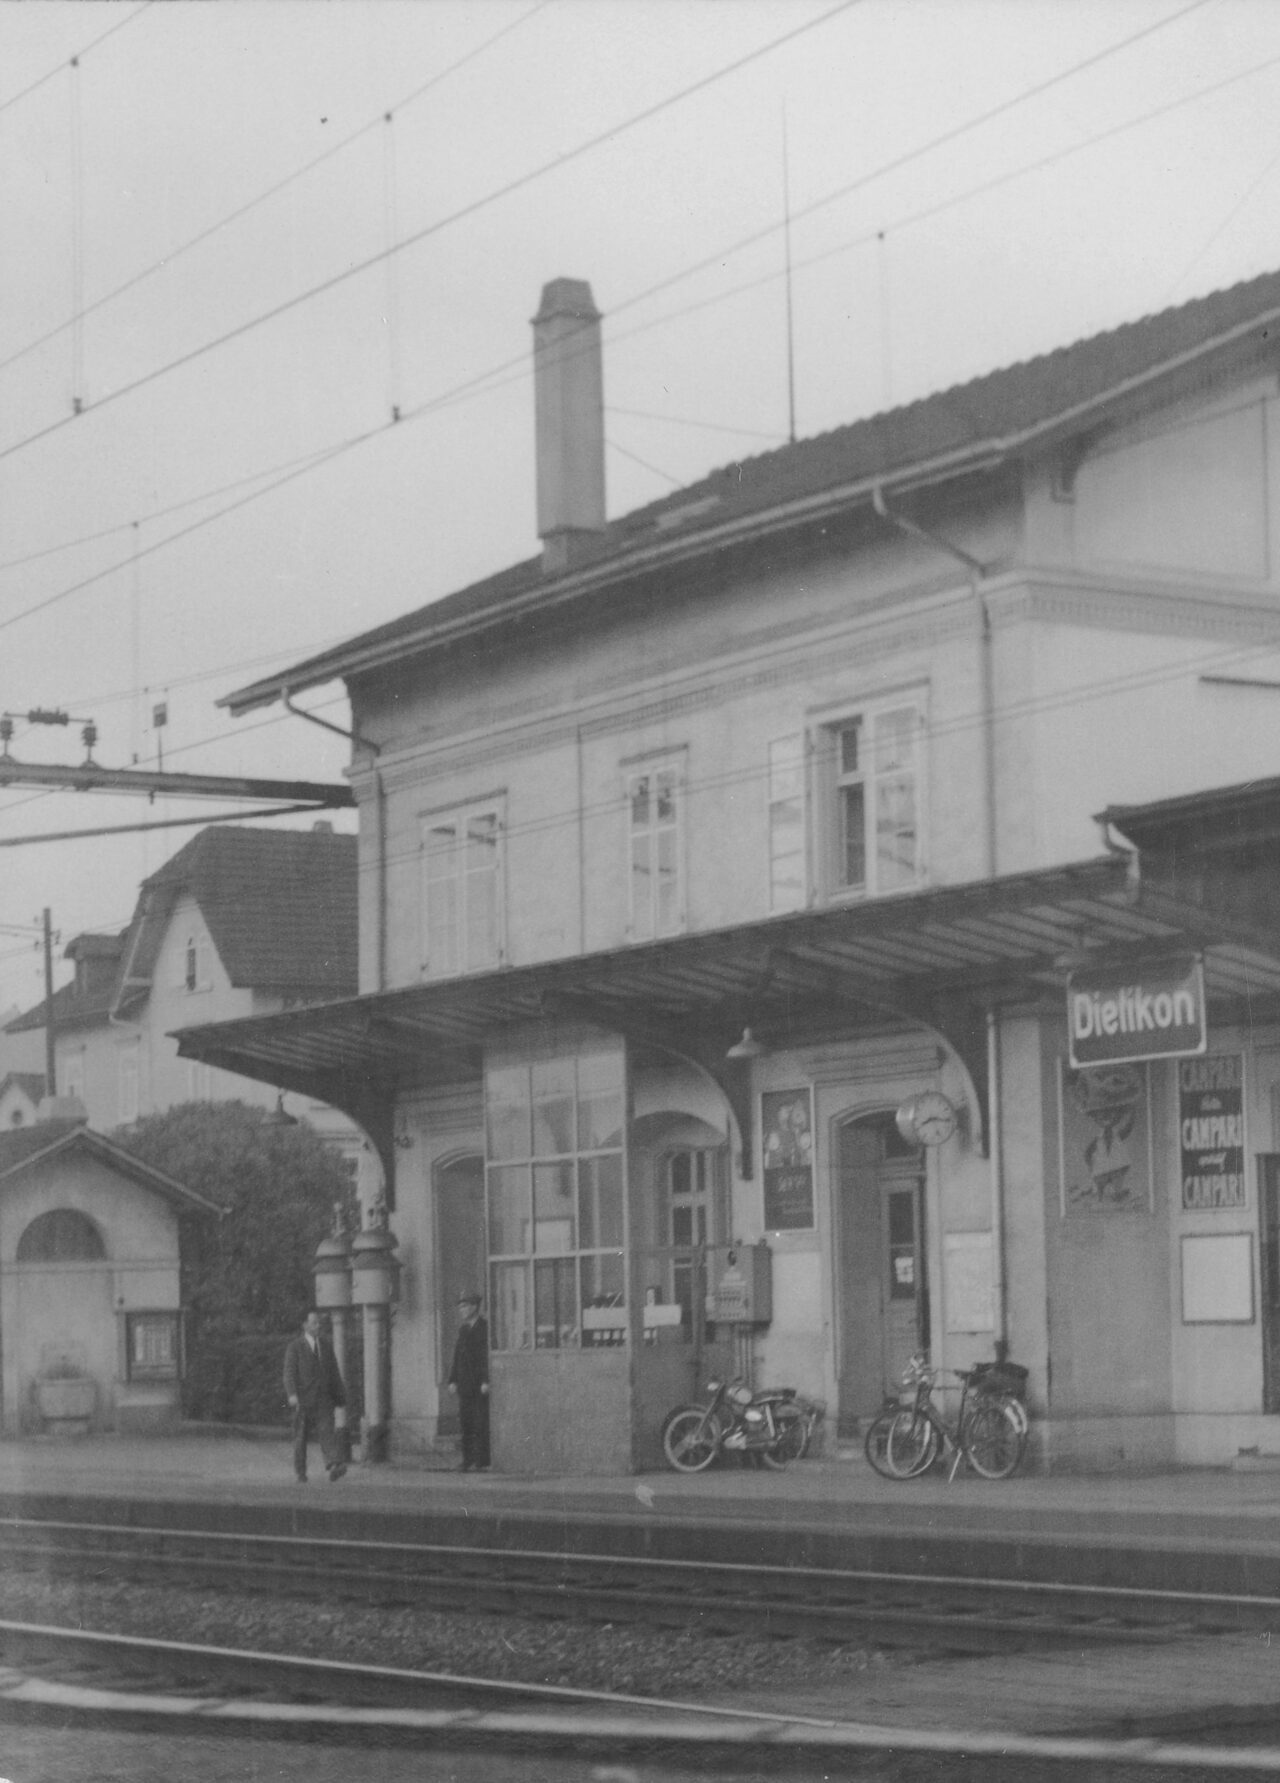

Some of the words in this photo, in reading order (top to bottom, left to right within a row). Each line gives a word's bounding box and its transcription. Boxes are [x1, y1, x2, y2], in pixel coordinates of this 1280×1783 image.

[1074, 986, 1195, 1040] Dietikon
[1183, 1115, 1243, 1150] CAMPARI
[1184, 1174, 1245, 1209] CAMPARI
